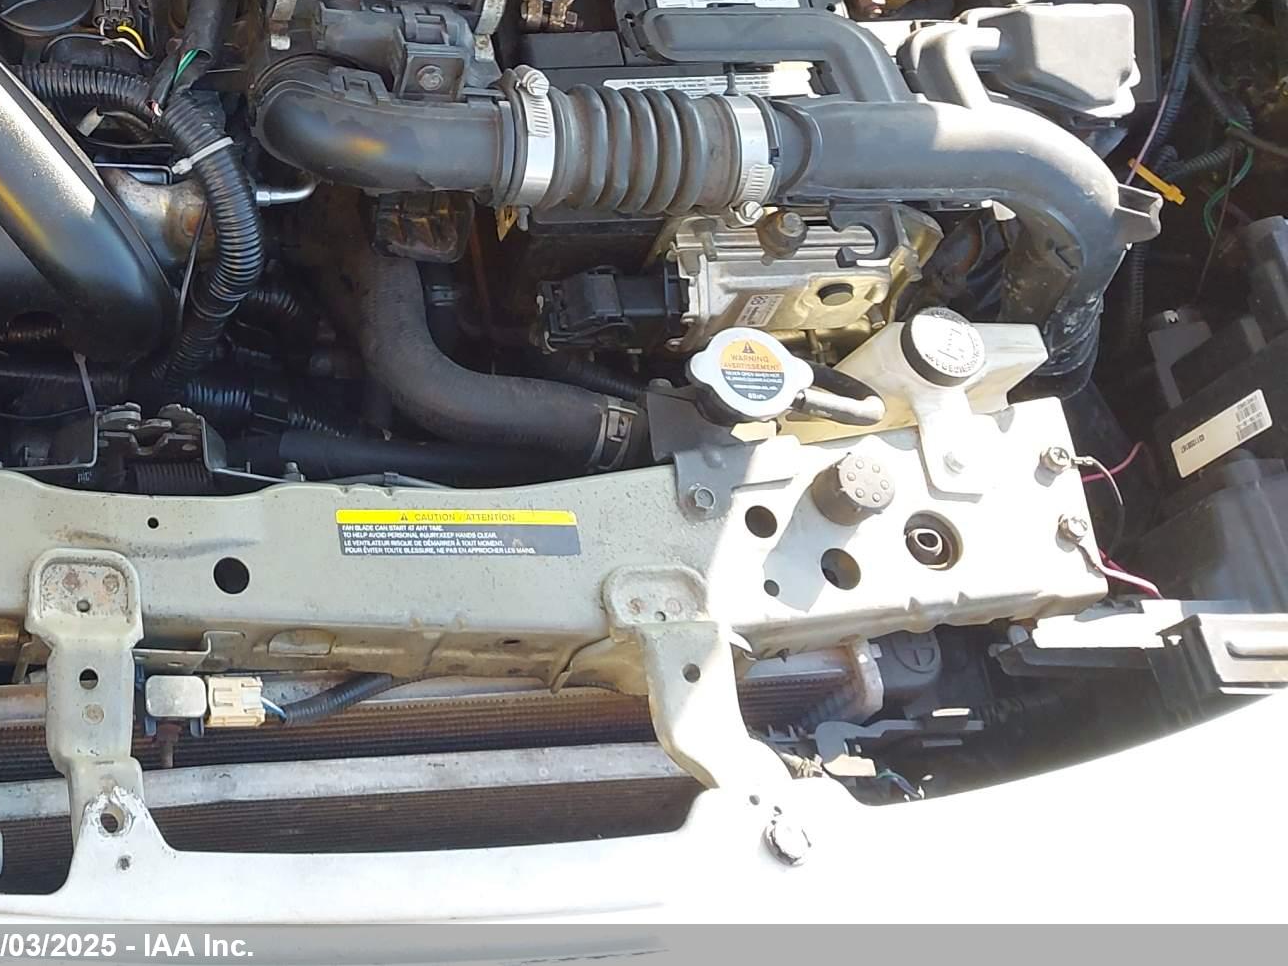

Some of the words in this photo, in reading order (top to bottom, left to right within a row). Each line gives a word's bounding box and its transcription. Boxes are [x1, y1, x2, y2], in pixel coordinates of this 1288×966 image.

[729, 354, 769, 363] WARNING
[723, 363, 780, 371] AVERTISSEMENT
[414, 513, 455, 522] CAUTION
[465, 513, 515, 522] ATTENTION
[422, 538, 456, 546] DÉMARRER
[363, 546, 383, 554] ÉVITER
